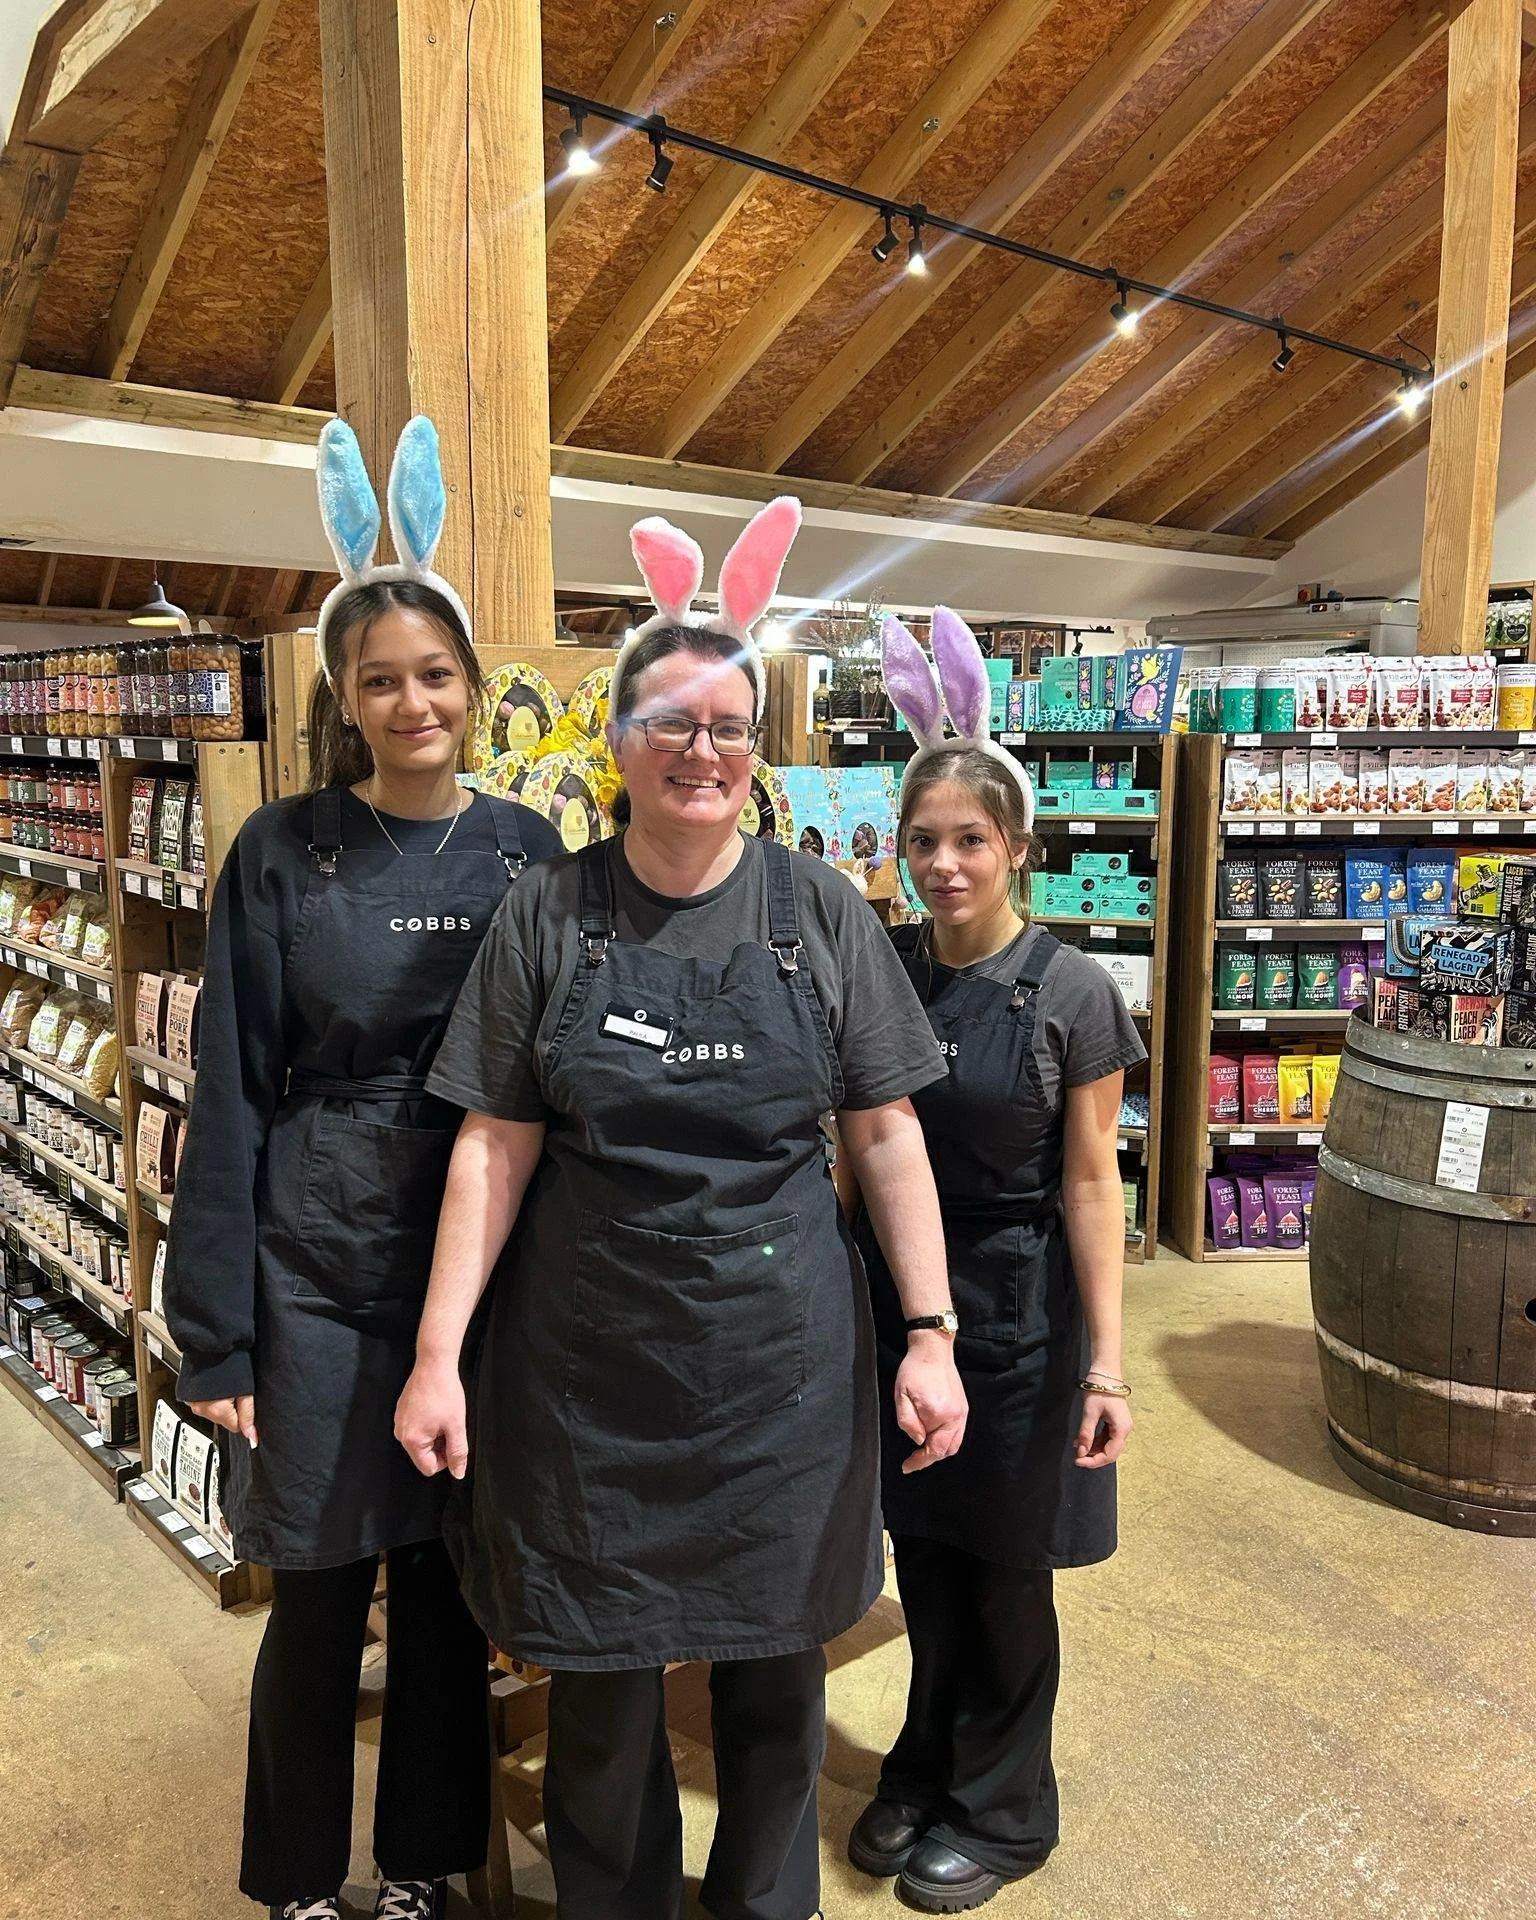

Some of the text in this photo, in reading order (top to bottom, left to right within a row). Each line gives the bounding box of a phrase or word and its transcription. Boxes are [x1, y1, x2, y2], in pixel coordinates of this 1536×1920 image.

[1506, 866, 1524, 876] LAGER
[1503, 875, 1514, 912] RENEGADE
[390, 917, 471, 931] COBBS
[1434, 948, 1486, 964] RENEGADE
[1442, 959, 1474, 972] LAGER
[138, 1000, 156, 1016] CHILLI
[1398, 990, 1409, 1030] BREWSKI
[1456, 996, 1487, 1011] BREWSKI
[170, 1012, 188, 1025] PULLED
[1454, 1011, 1478, 1026] PEACH
[169, 1020, 188, 1035] PORK
[1454, 1026, 1477, 1040] LAGER
[662, 1044, 744, 1064] COBBS
[937, 1040, 958, 1056] BS
[1289, 1105, 1311, 1113] MANG
[140, 1130, 159, 1148] CHILLI
[1221, 1194, 1235, 1202] FEAS
[180, 1459, 201, 1484] TAGINE
